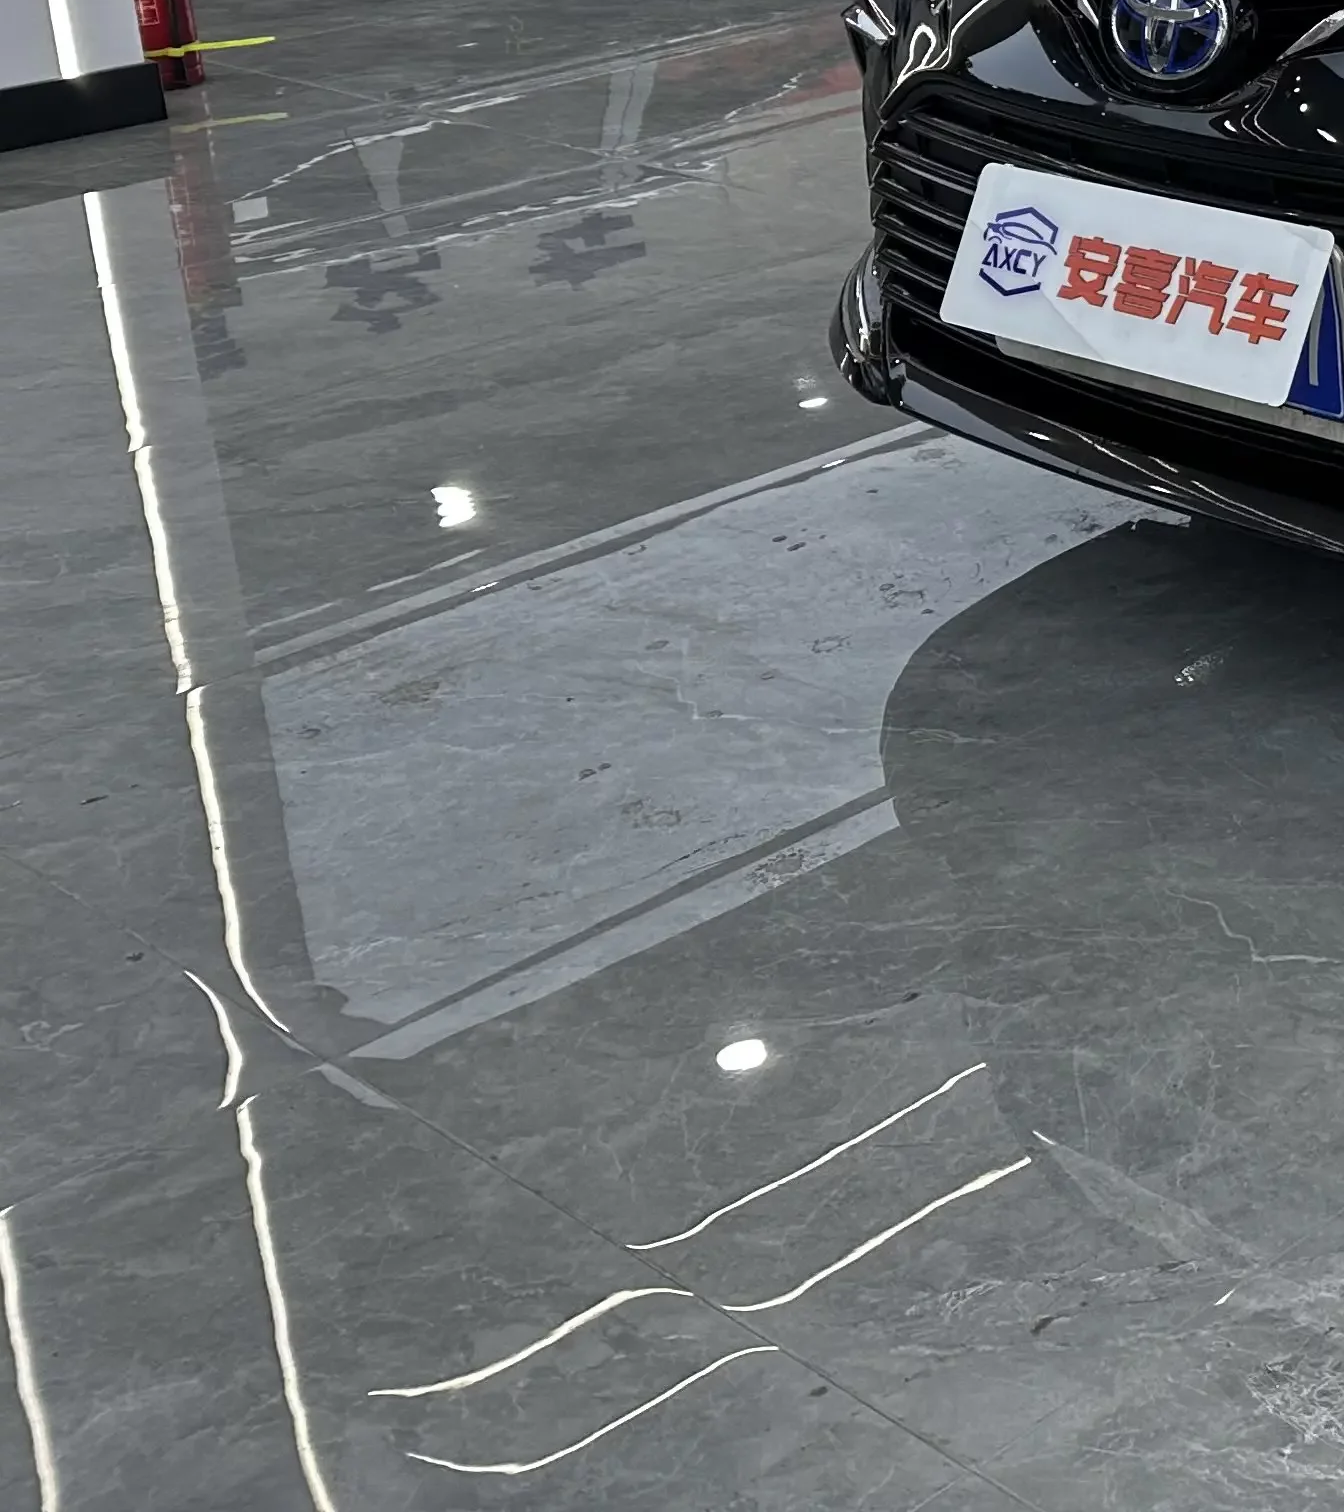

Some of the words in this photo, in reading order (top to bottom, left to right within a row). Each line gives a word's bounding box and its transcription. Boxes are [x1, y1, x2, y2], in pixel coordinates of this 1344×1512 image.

[982, 243, 1045, 278] AXCY
[1056, 236, 1299, 345] 安喜汽车
